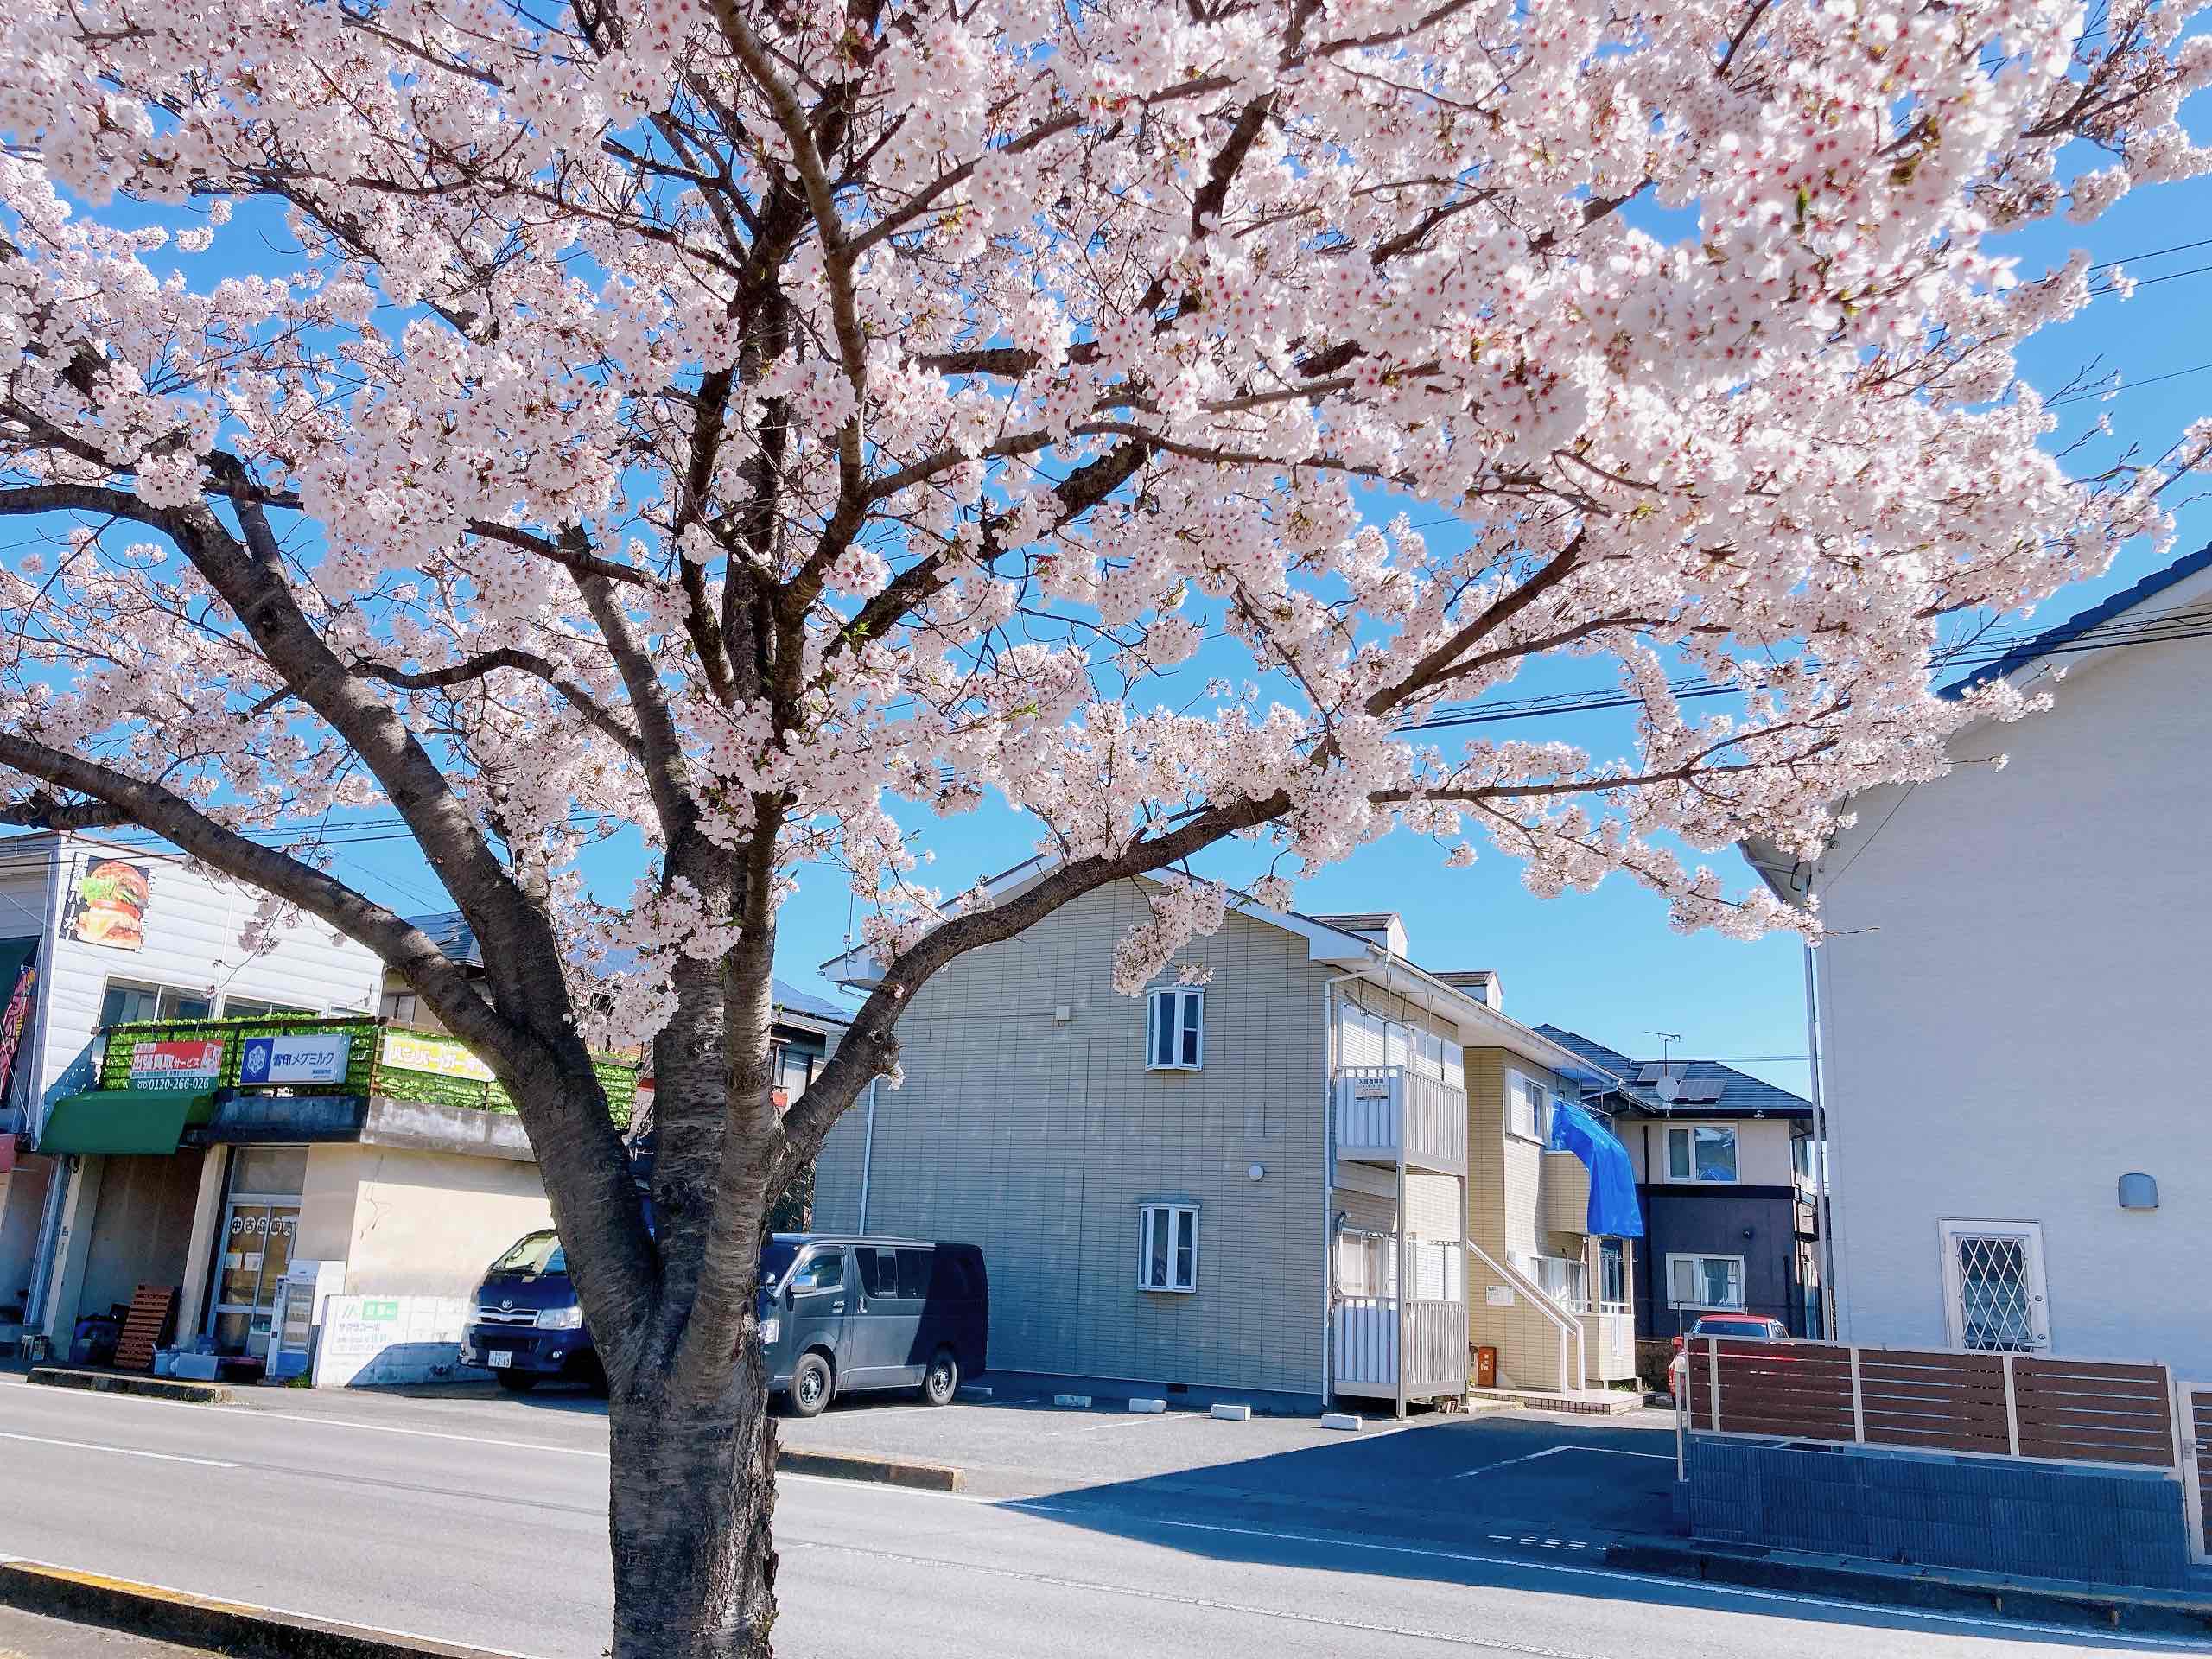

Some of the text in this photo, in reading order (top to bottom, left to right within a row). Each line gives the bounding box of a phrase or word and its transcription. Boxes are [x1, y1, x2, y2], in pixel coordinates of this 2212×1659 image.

[273, 1052, 334, 1066] 雪印メグミルク
[149, 1078, 209, 1090] 0120-266-026
